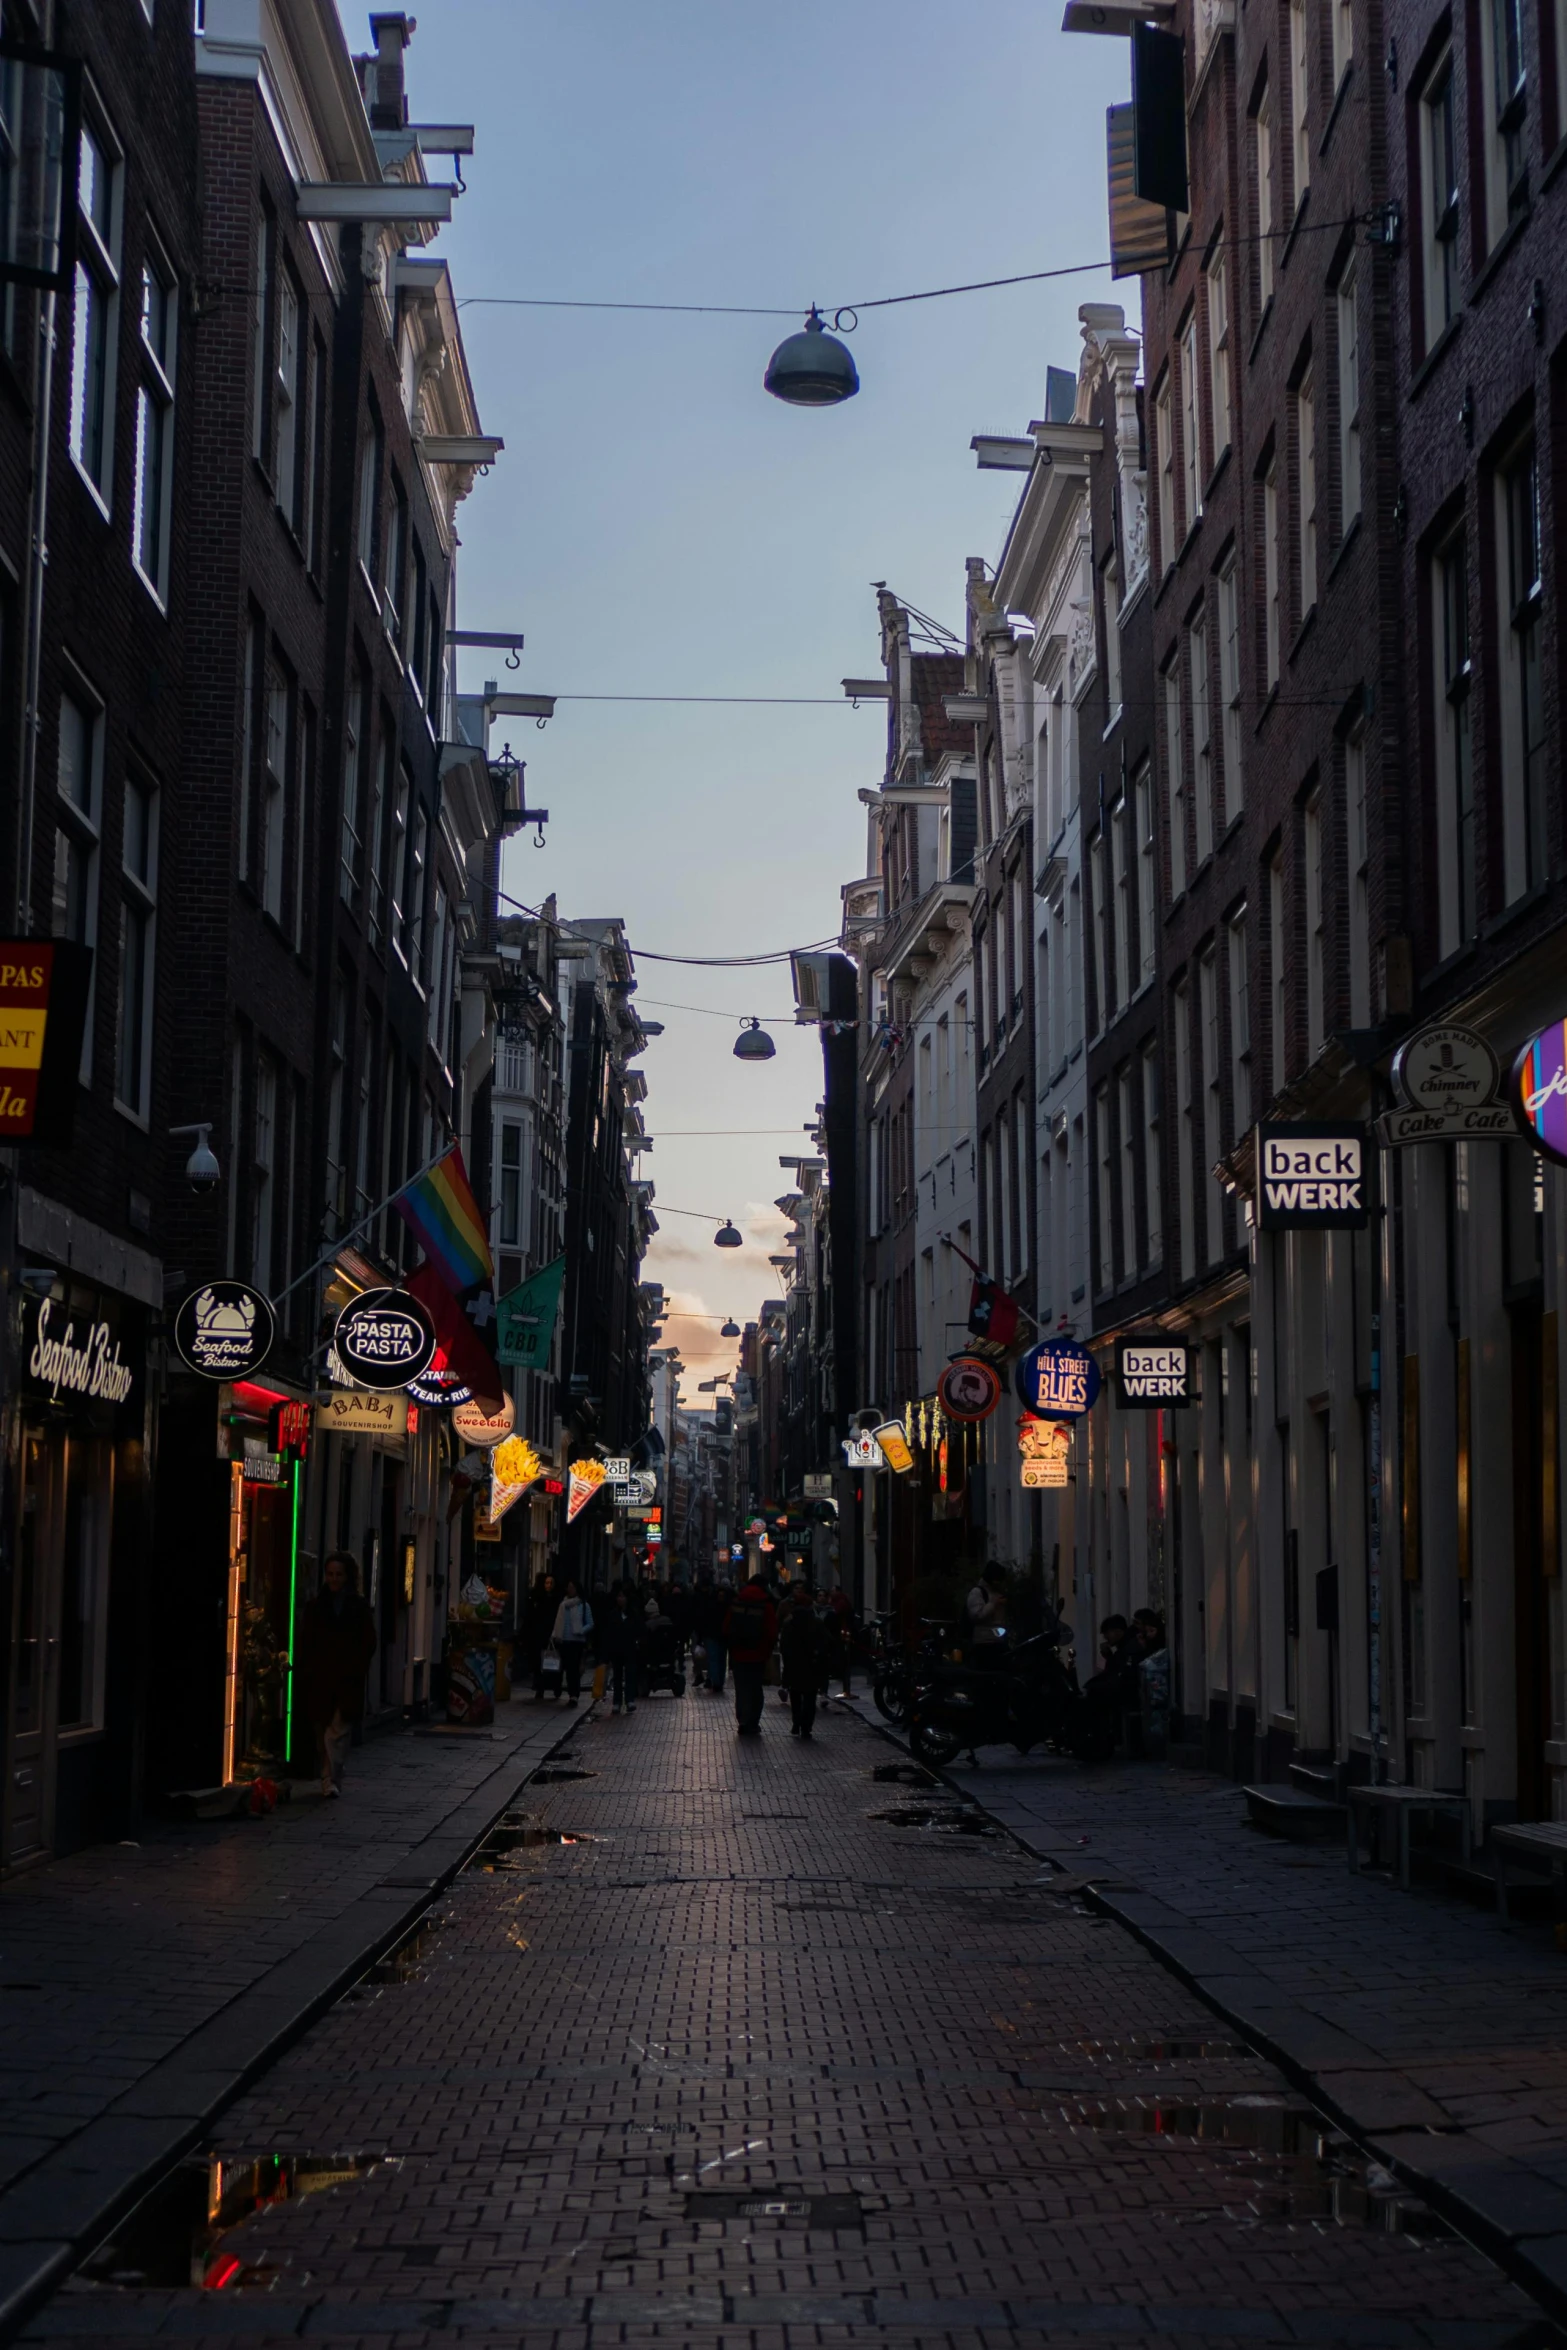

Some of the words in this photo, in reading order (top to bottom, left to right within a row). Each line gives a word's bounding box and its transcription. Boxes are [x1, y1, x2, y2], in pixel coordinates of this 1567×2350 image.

[0, 964, 45, 989] PAS
[1421, 1031, 1449, 1049] HOME
[1452, 1032, 1480, 1050] MADE
[1420, 1078, 1480, 1093] Chimney
[1398, 1114, 1446, 1136] Cake
[1464, 1110, 1509, 1129] Café
[1270, 1143, 1355, 1175] back
[1265, 1183, 1361, 1209] WERK
[356, 1321, 414, 1339] PASTA
[30, 1297, 93, 1400] Seafood
[88, 1321, 132, 1403] Bistro
[192, 1335, 254, 1356] Seafood
[355, 1338, 412, 1356] PASTA
[503, 1330, 538, 1353] CBD
[1043, 1347, 1084, 1358] CAFE
[1126, 1350, 1182, 1372] back
[1037, 1355, 1056, 1371] HILL
[1058, 1357, 1090, 1375] STREET
[405, 1381, 444, 1403] STEAK
[1038, 1372, 1087, 1403] BLUES
[1123, 1377, 1187, 1397] WERK
[331, 1395, 394, 1420] BABA
[1046, 1402, 1075, 1410] BAR
[332, 1419, 394, 1430] SOUVENIRSHOP
